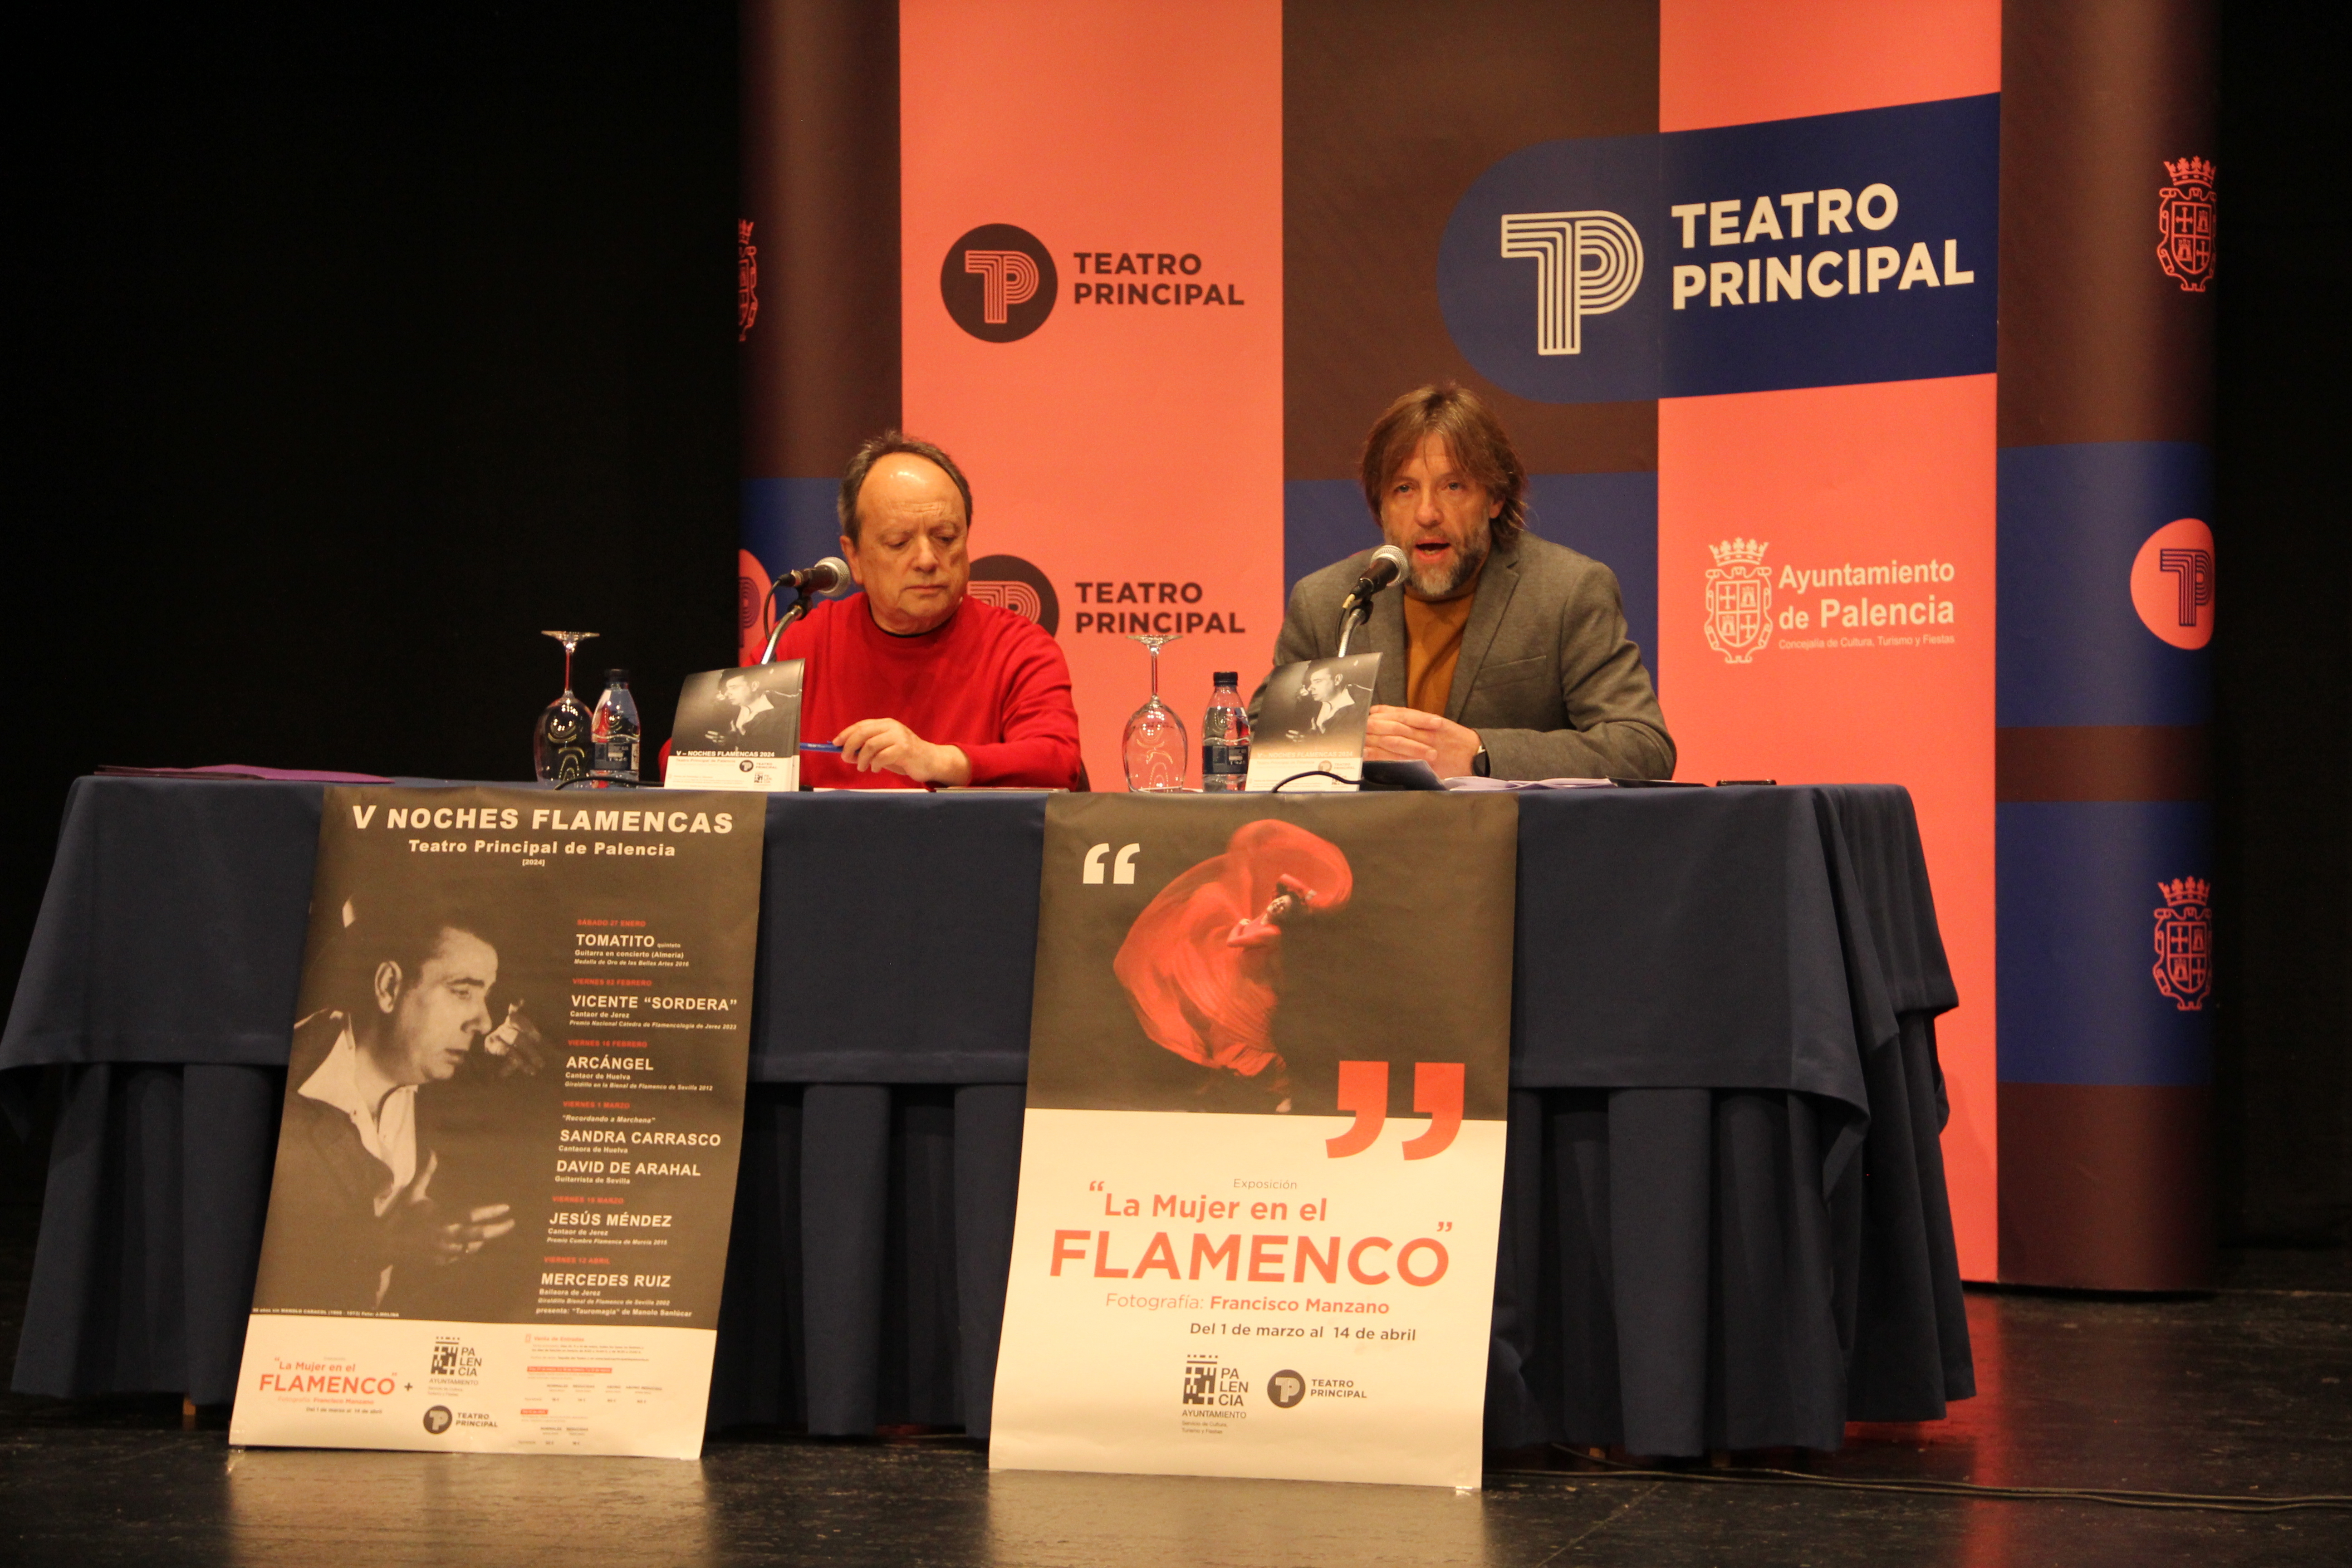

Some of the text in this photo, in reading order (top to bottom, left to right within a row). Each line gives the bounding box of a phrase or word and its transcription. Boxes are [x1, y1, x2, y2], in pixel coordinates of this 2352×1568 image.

[1671, 182, 1899, 249] TEATRO
[1073, 252, 1202, 275] TEATRO
[1673, 238, 1975, 310] PRINCIPAL
[1074, 283, 1245, 306] PRINCIPAL
[1778, 559, 1955, 594] Ayuntamiento
[1075, 582, 1203, 604] TEATRO
[1779, 594, 1955, 630] de Palencia
[1076, 612, 1245, 633] PRINCIPAL
[1827, 637, 1838, 648] de
[1840, 636, 1875, 648] Cultura,
[1877, 635, 1913, 647] Turismo
[1915, 637, 1921, 647] y
[1922, 633, 1955, 645] Fiestas
[351, 805, 734, 834] V NOCHES FLAMENCAS
[408, 839, 676, 857] Teatro Principal de Palencia
[522, 858, 546, 867] [2024]
[576, 934, 655, 947] TOMATITO
[571, 995, 638, 1008] VICENTE
[566, 1054, 654, 1071] ARCÁNGEL
[560, 1128, 721, 1147] SANDRA CARRASCO
[556, 1160, 701, 1176] DAVID DE ARAHAL
[554, 1176, 593, 1184] Guitarrista
[1233, 1178, 1298, 1191] Exposición
[1152, 1194, 1240, 1223] Mujer
[1250, 1199, 1288, 1220] en
[1299, 1197, 1328, 1221] el
[549, 1210, 672, 1228] JESÚS MÉNDEZ
[541, 1272, 671, 1288] MERCEDES RUIZ
[539, 1288, 569, 1296] Bailaora
[1105, 1292, 1391, 1315] Fotografía: Francisco Manzano
[1190, 1322, 1417, 1341] Del 1 de marzo al 14 de abril
[461, 1347, 475, 1356] PA
[295, 1361, 327, 1372] Mujer
[346, 1364, 356, 1372] el
[459, 1357, 482, 1367] LEN
[458, 1367, 477, 1377] CIA
[1220, 1367, 1240, 1380] PA
[1219, 1380, 1249, 1393] LEN
[1311, 1379, 1354, 1388] TEATRO
[1218, 1394, 1244, 1406] CIA
[1310, 1389, 1367, 1399] PRINCIPAL
[1182, 1409, 1247, 1419] AYUNTAMIENTO
[456, 1420, 498, 1428] PRINCIPAL
